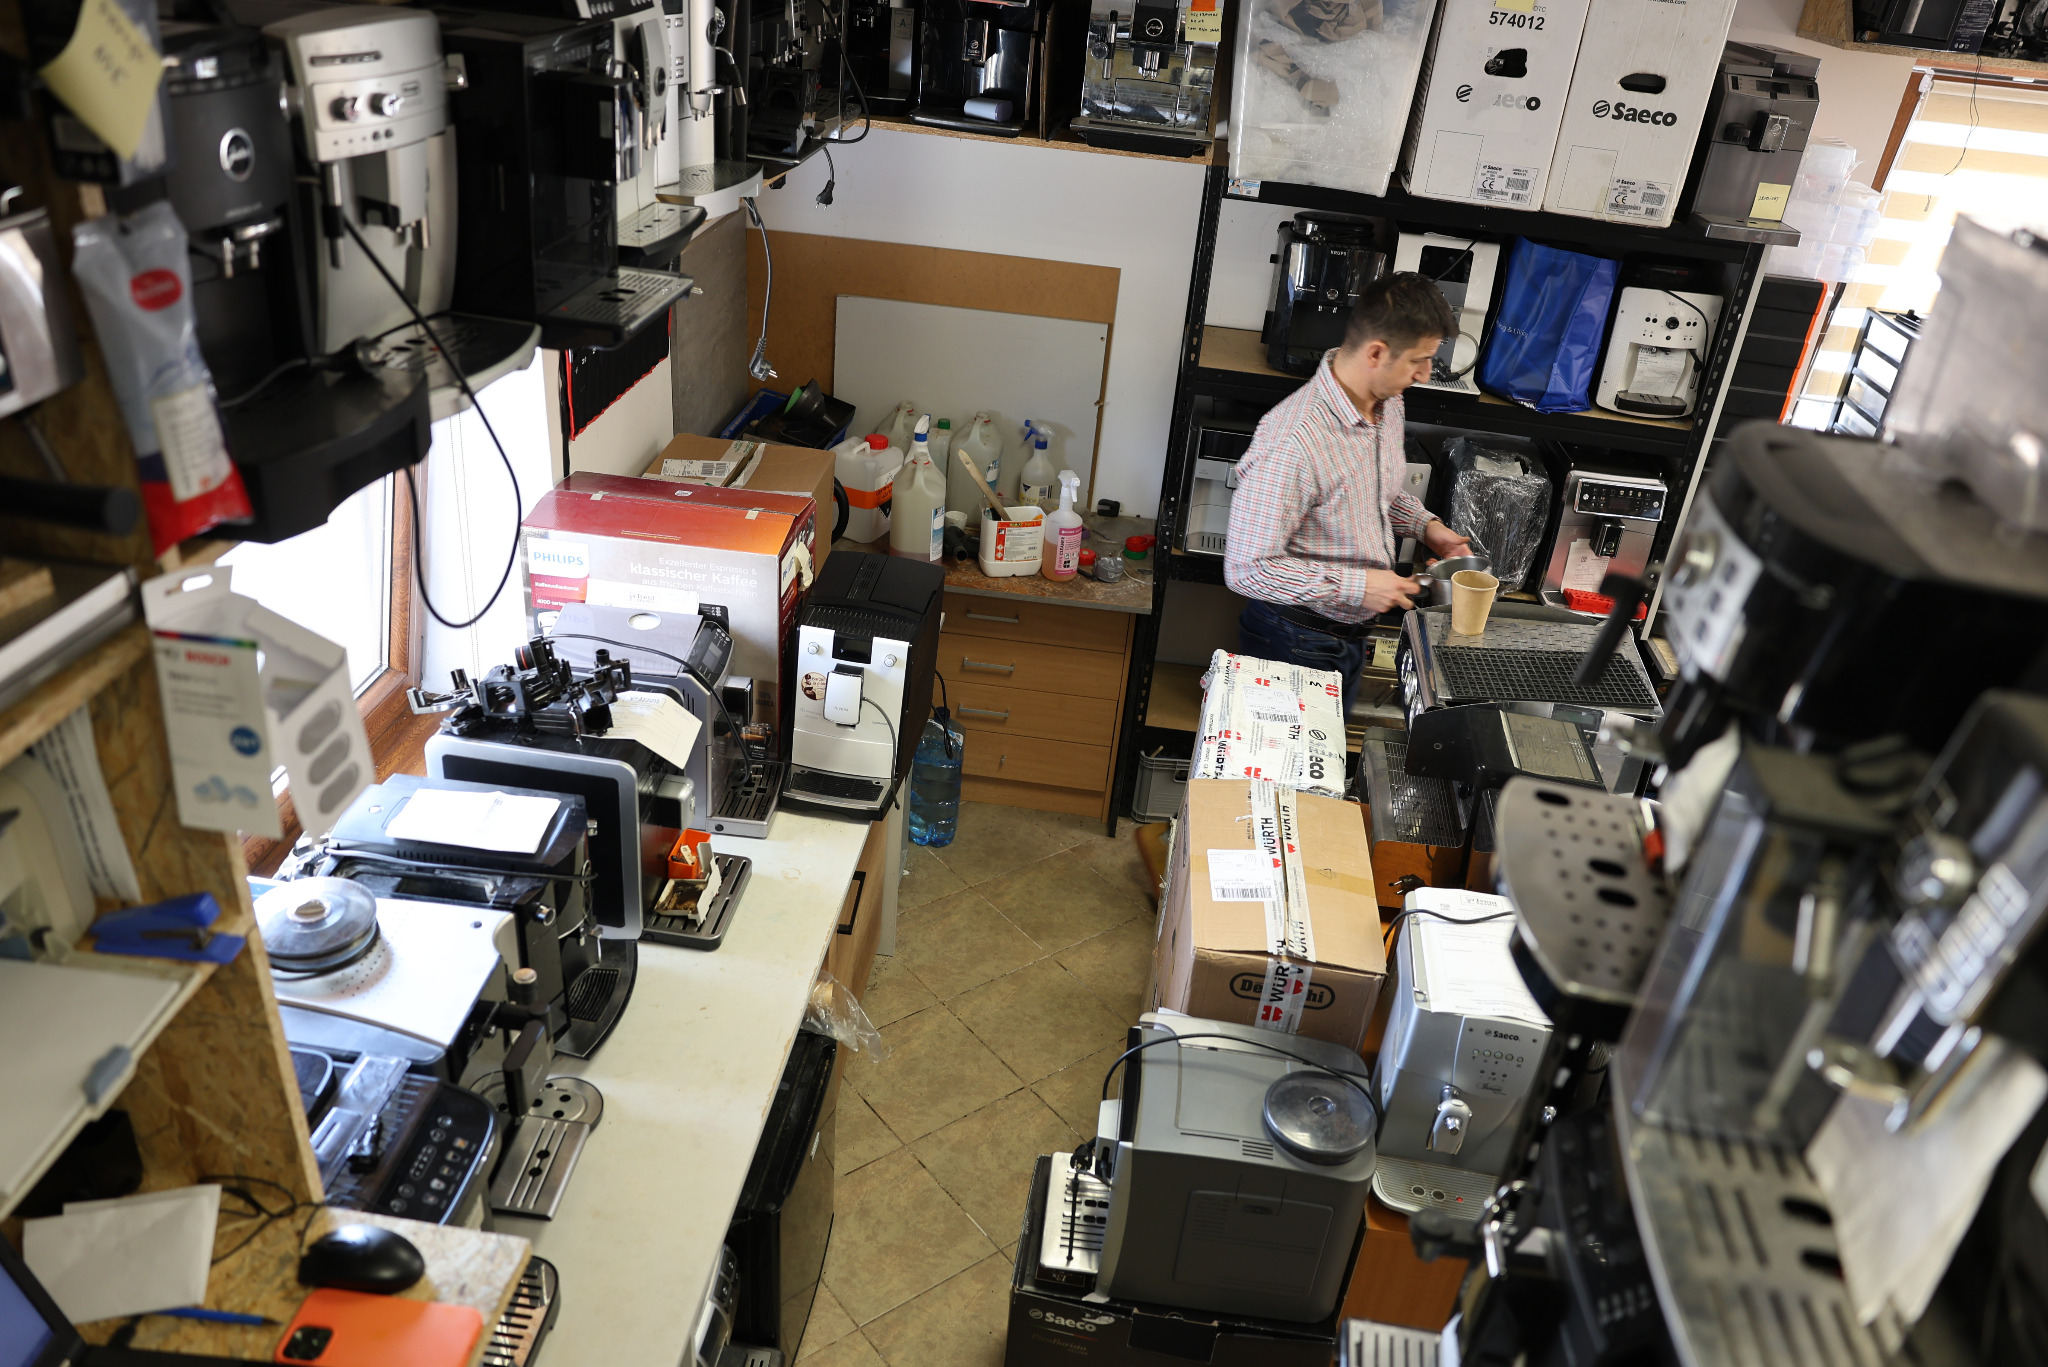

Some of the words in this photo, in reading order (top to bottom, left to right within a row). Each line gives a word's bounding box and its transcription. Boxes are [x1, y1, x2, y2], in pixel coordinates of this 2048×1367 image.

[1488, 11, 1546, 31] 574012
[1611, 101, 1678, 127] Saeco
[1620, 178, 1636, 186] Saeco
[533, 551, 584, 566] PHILIPS
[658, 557, 707, 570] Exzellenter
[709, 563, 749, 576] Espresso
[751, 567, 758, 576] &
[630, 562, 707, 582] klassischer
[712, 572, 758, 588] Kaffee
[642, 578, 658, 586] aus
[659, 579, 694, 590] frischen
[696, 583, 758, 598] Kaffeebohnen
[537, 598, 551, 606] 4000
[1260, 817, 1277, 855] WÜRTH
[1493, 1030, 1519, 1041] Saeco
[1045, 1312, 1097, 1332] Saeco
